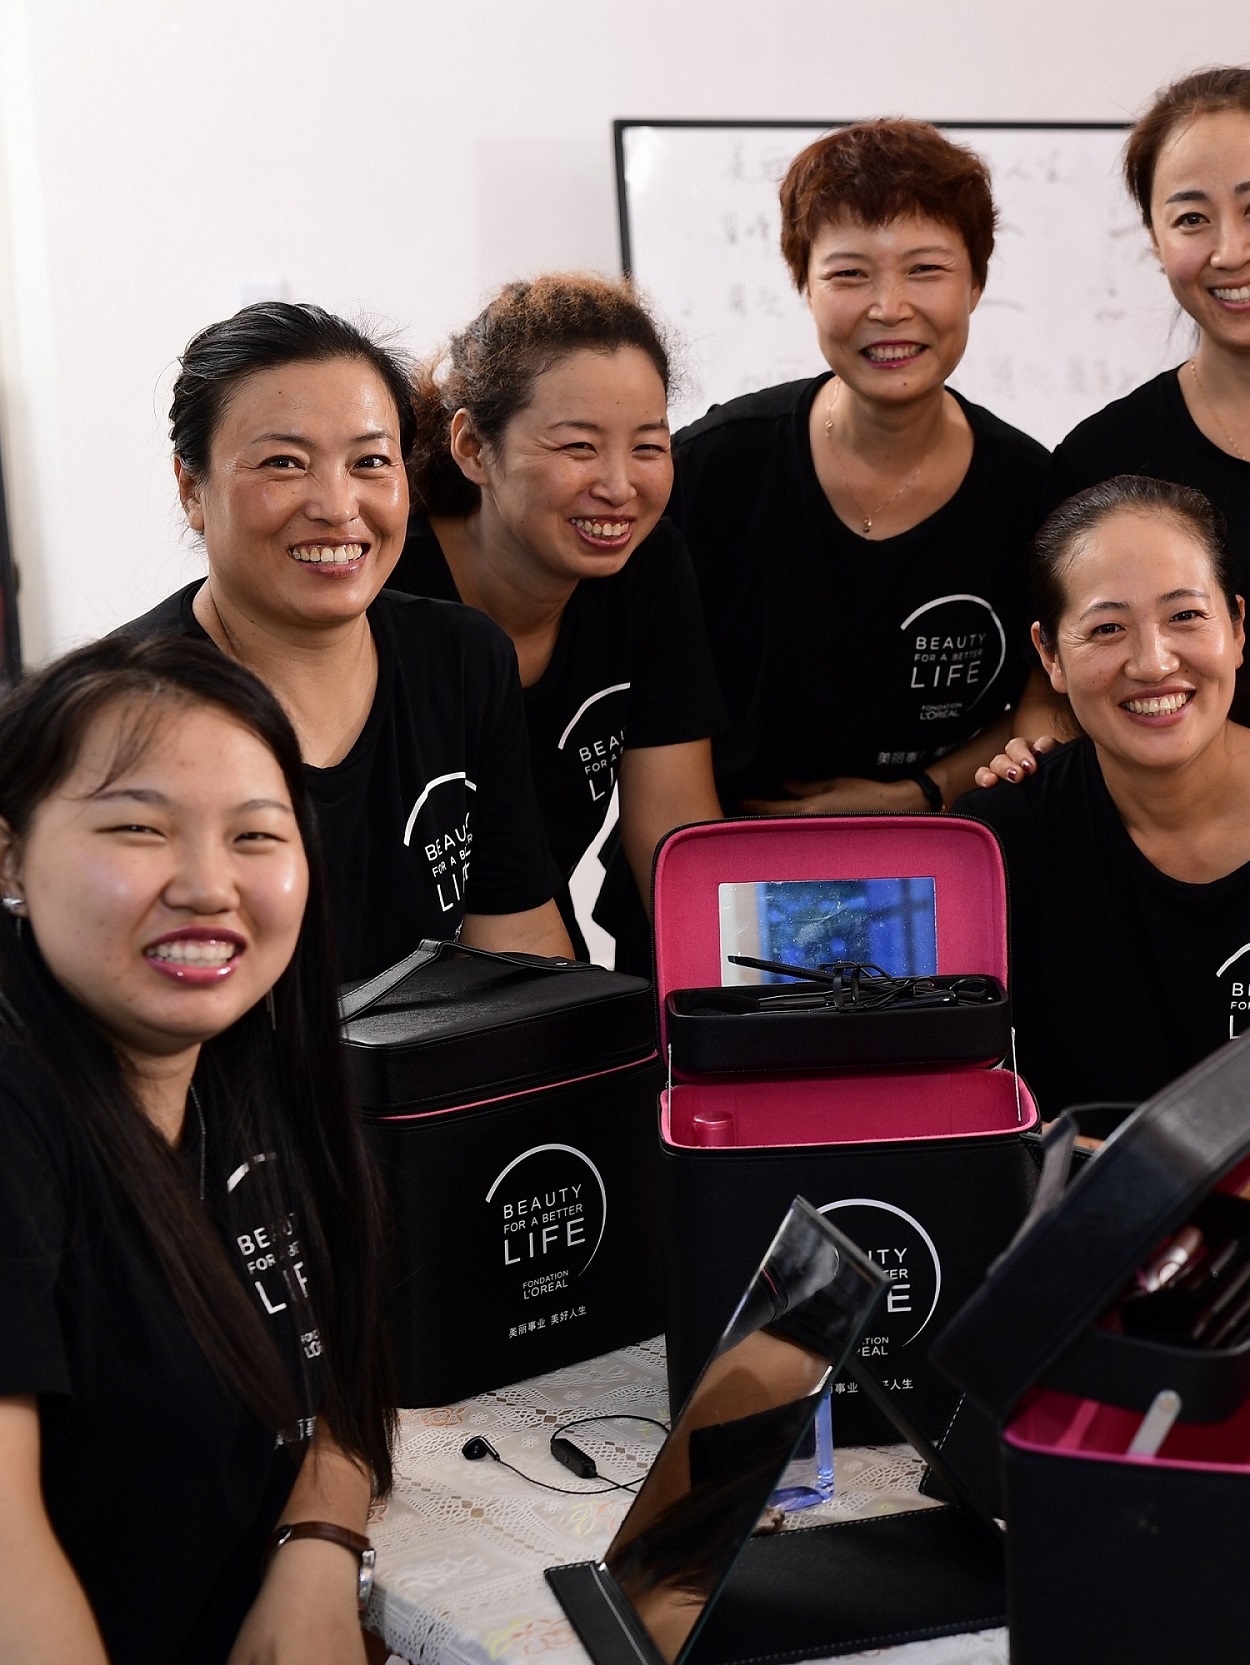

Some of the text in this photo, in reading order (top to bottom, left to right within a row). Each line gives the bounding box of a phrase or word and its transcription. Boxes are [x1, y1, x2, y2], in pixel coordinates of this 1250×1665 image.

[915, 632, 986, 650] BEAUTY
[914, 649, 983, 662] FOR A BETTER
[910, 660, 981, 688] LIFE
[584, 754, 617, 775] FOR A
[424, 812, 470, 861] BEAU
[432, 856, 457, 877] FOR A
[503, 1184, 582, 1219] BEAUTY
[504, 1203, 583, 1234] FOR A BETTER
[504, 1217, 586, 1265] LIFE
[247, 1253, 276, 1275] FOR
[522, 1270, 569, 1289] FONDATION
[508, 1305, 587, 1339] 美丽事业 美好人生
